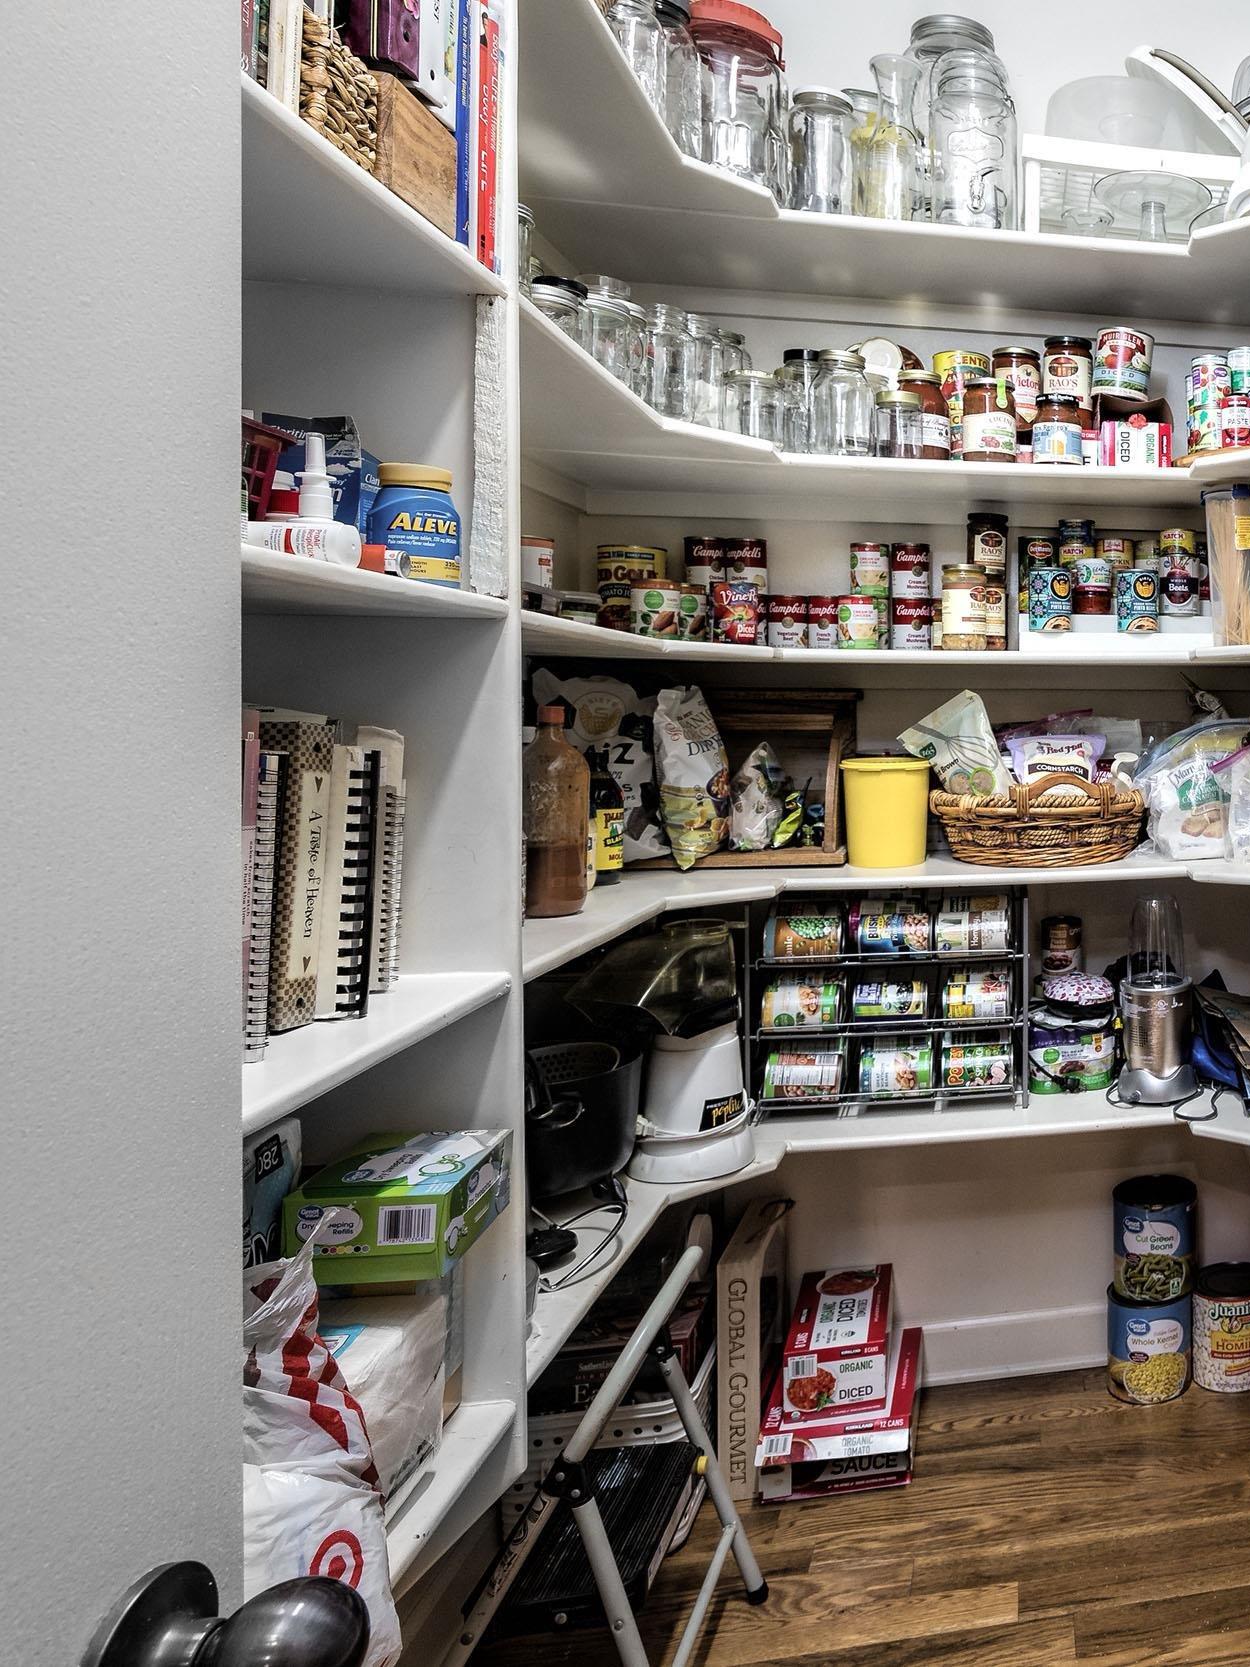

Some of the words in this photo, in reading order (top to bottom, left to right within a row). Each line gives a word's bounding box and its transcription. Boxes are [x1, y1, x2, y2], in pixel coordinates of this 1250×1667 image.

[1103, 331, 1119, 342] MUIR
[1122, 332, 1141, 345] GLEN
[1101, 369, 1135, 378] DICED
[1048, 379, 1078, 388] RAO'S
[1120, 431, 1131, 463] DICED
[387, 511, 458, 537] ALEVE
[1062, 548, 1084, 556] HATCH
[1168, 583, 1189, 592] Beets
[738, 624, 756, 634] Diced
[1046, 745, 1062, 755] Red
[1064, 742, 1084, 753] Mill
[939, 758, 960, 774] Brown
[1036, 764, 1084, 776] CORNSTARCH
[309, 809, 323, 824] A
[307, 826, 322, 865] Taste
[306, 867, 321, 886] of
[303, 888, 320, 939] Heaven
[969, 918, 981, 947] Hominy
[301, 1222, 316, 1230] Dry
[1124, 1218, 1141, 1229] Great
[1135, 1234, 1149, 1244] Cut
[1149, 1234, 1175, 1244] Green
[1150, 1242, 1174, 1251] Beans
[837, 1298, 856, 1323] DICED
[727, 1277, 749, 1368] GLOBAL
[1128, 1321, 1147, 1332] Great
[1131, 1337, 1156, 1346] Whole
[1156, 1334, 1179, 1345] Kernel
[868, 1345, 879, 1353] CANS
[839, 1359, 874, 1374] ORGANIC
[839, 1385, 873, 1401] DICED
[727, 1374, 749, 1485] GOURMET
[845, 1423, 874, 1432] KIRKLAND
[879, 1421, 887, 1429] 12
[887, 1418, 905, 1428] CANS
[841, 1434, 874, 1448] ORGANIC
[843, 1444, 871, 1457] TOMATO
[830, 1454, 899, 1477] SAUCE
